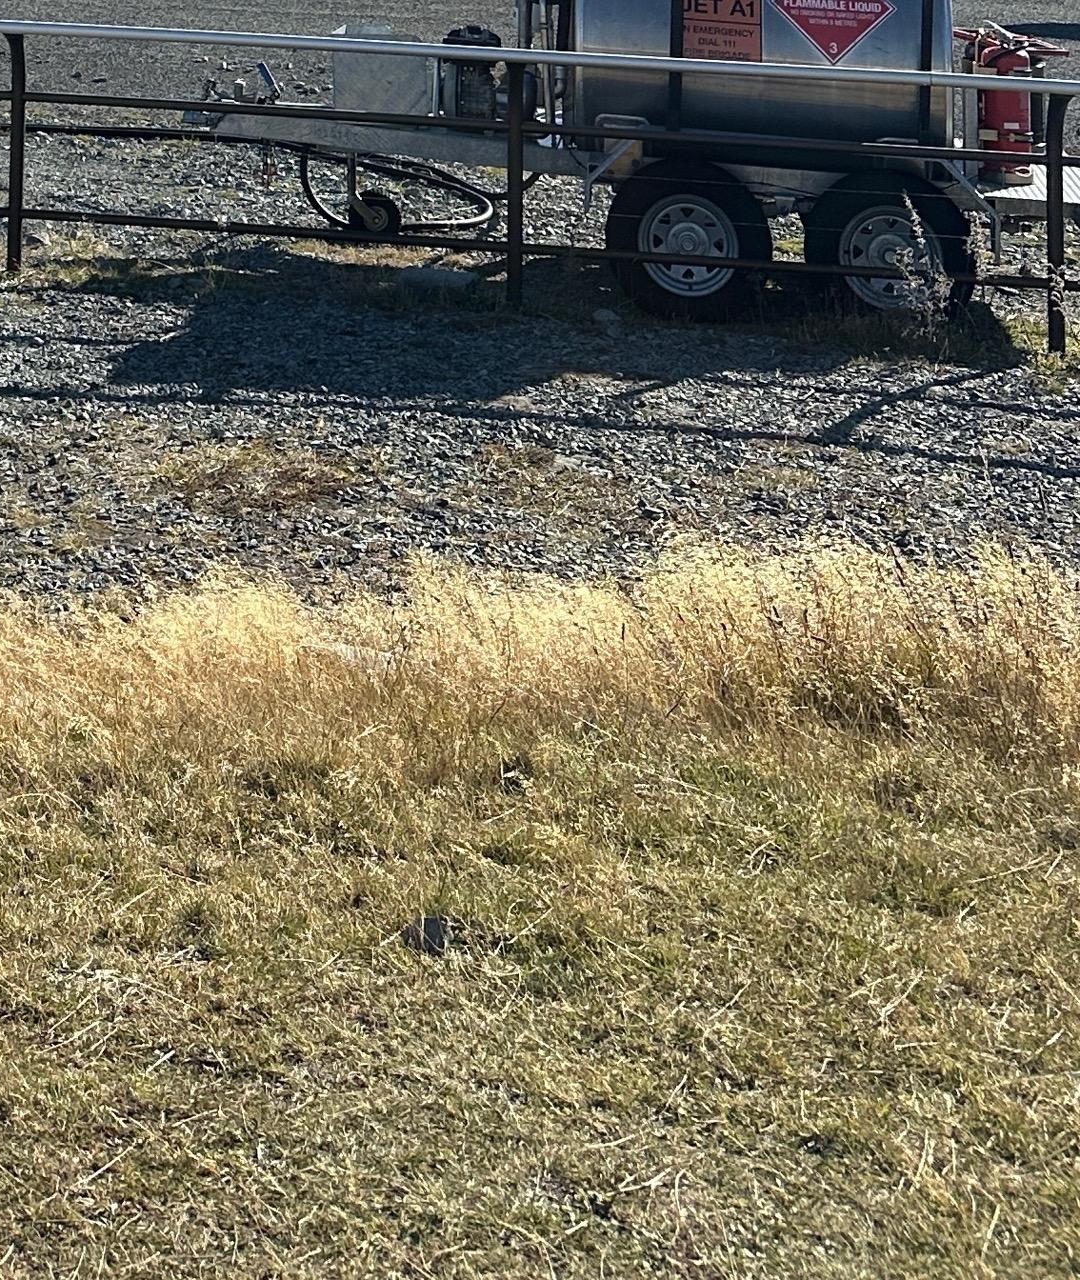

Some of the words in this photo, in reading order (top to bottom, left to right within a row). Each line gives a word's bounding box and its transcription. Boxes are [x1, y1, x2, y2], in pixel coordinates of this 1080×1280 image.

[729, 0, 755, 18] A1
[848, 1, 882, 13] LIQUID
[693, 25, 754, 38] EMERGENCY
[697, 37, 720, 47] DIAL
[828, 42, 838, 54] 3
